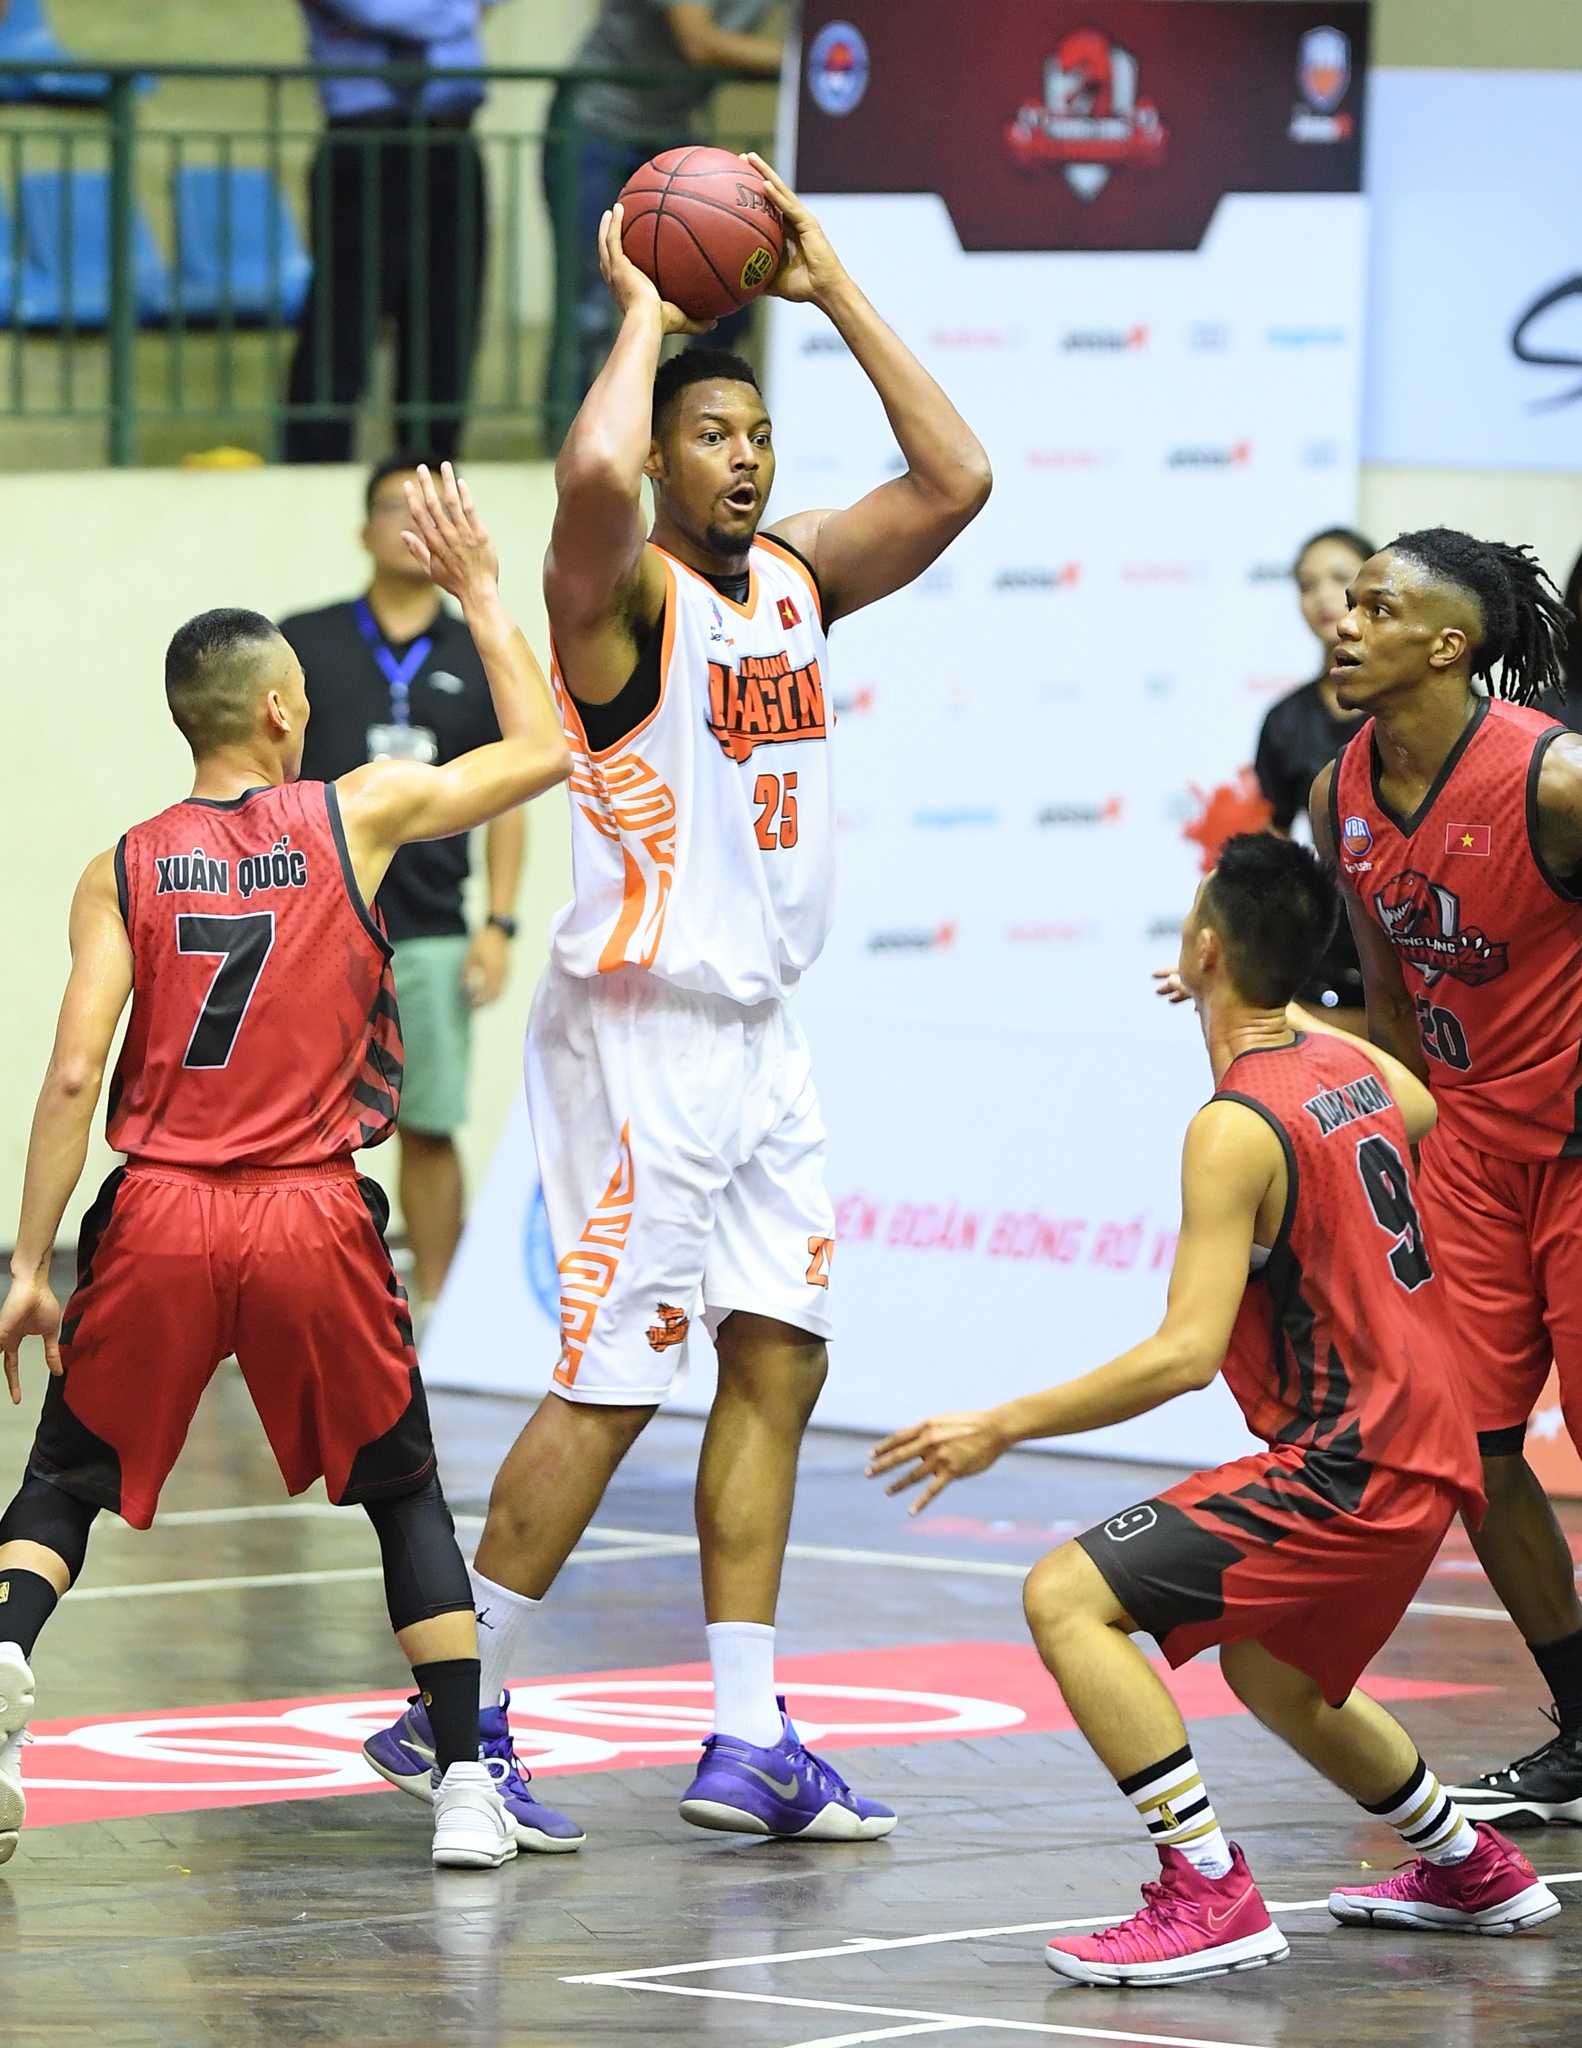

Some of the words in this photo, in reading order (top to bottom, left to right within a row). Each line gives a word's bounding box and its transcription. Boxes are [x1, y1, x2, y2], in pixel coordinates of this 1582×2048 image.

[753, 771, 798, 850] 25
[1345, 820, 1366, 836] VBA
[155, 847, 230, 895] XUÂN
[236, 834, 308, 899] QUỐC
[176, 911, 275, 1069] 7
[1415, 991, 1472, 1073] 20
[1356, 1133, 1435, 1293] 9
[1104, 1505, 1158, 1542] 9
